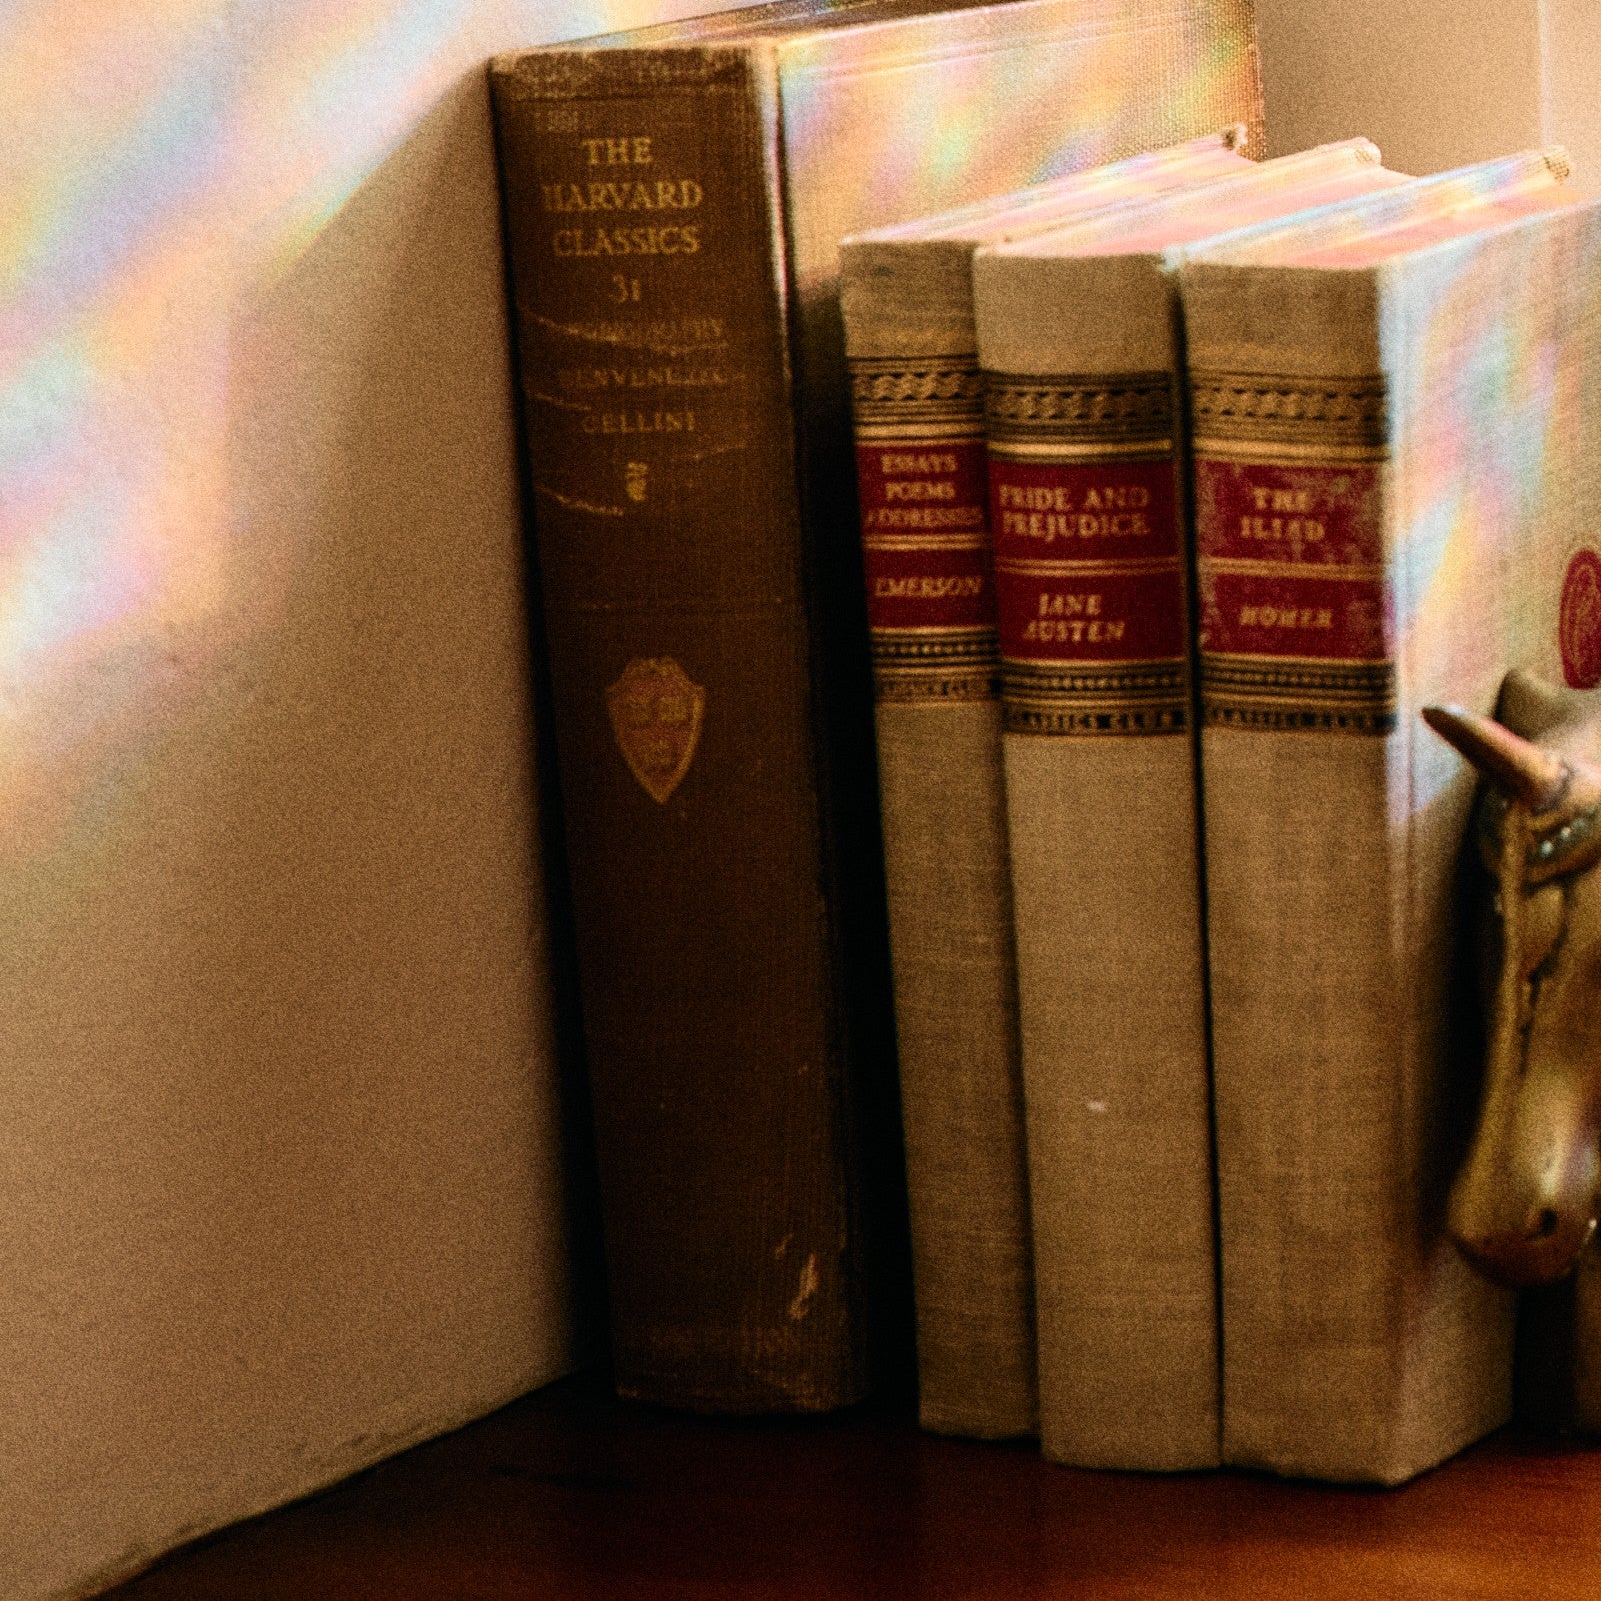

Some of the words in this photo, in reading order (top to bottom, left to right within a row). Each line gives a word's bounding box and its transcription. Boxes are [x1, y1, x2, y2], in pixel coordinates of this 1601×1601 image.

[581, 136, 653, 166] THE
[540, 179, 704, 212] HARVARD
[552, 225, 701, 258] CLASSICS
[608, 274, 641, 303] 31
[581, 411, 696, 433] CELLINI
[881, 453, 958, 475] ESSAYS
[885, 481, 957, 502] POEMS
[998, 484, 1073, 512] PRIDE
[1083, 487, 1151, 511] AND
[1253, 485, 1308, 512] THE
[1001, 511, 1151, 543] PREJUDICE
[1240, 515, 1326, 542] ILIAD
[874, 576, 984, 598] EMERSON
[1037, 592, 1102, 617] JANE
[1239, 604, 1333, 629] HOMER
[1021, 620, 1126, 643] AUSTEN
